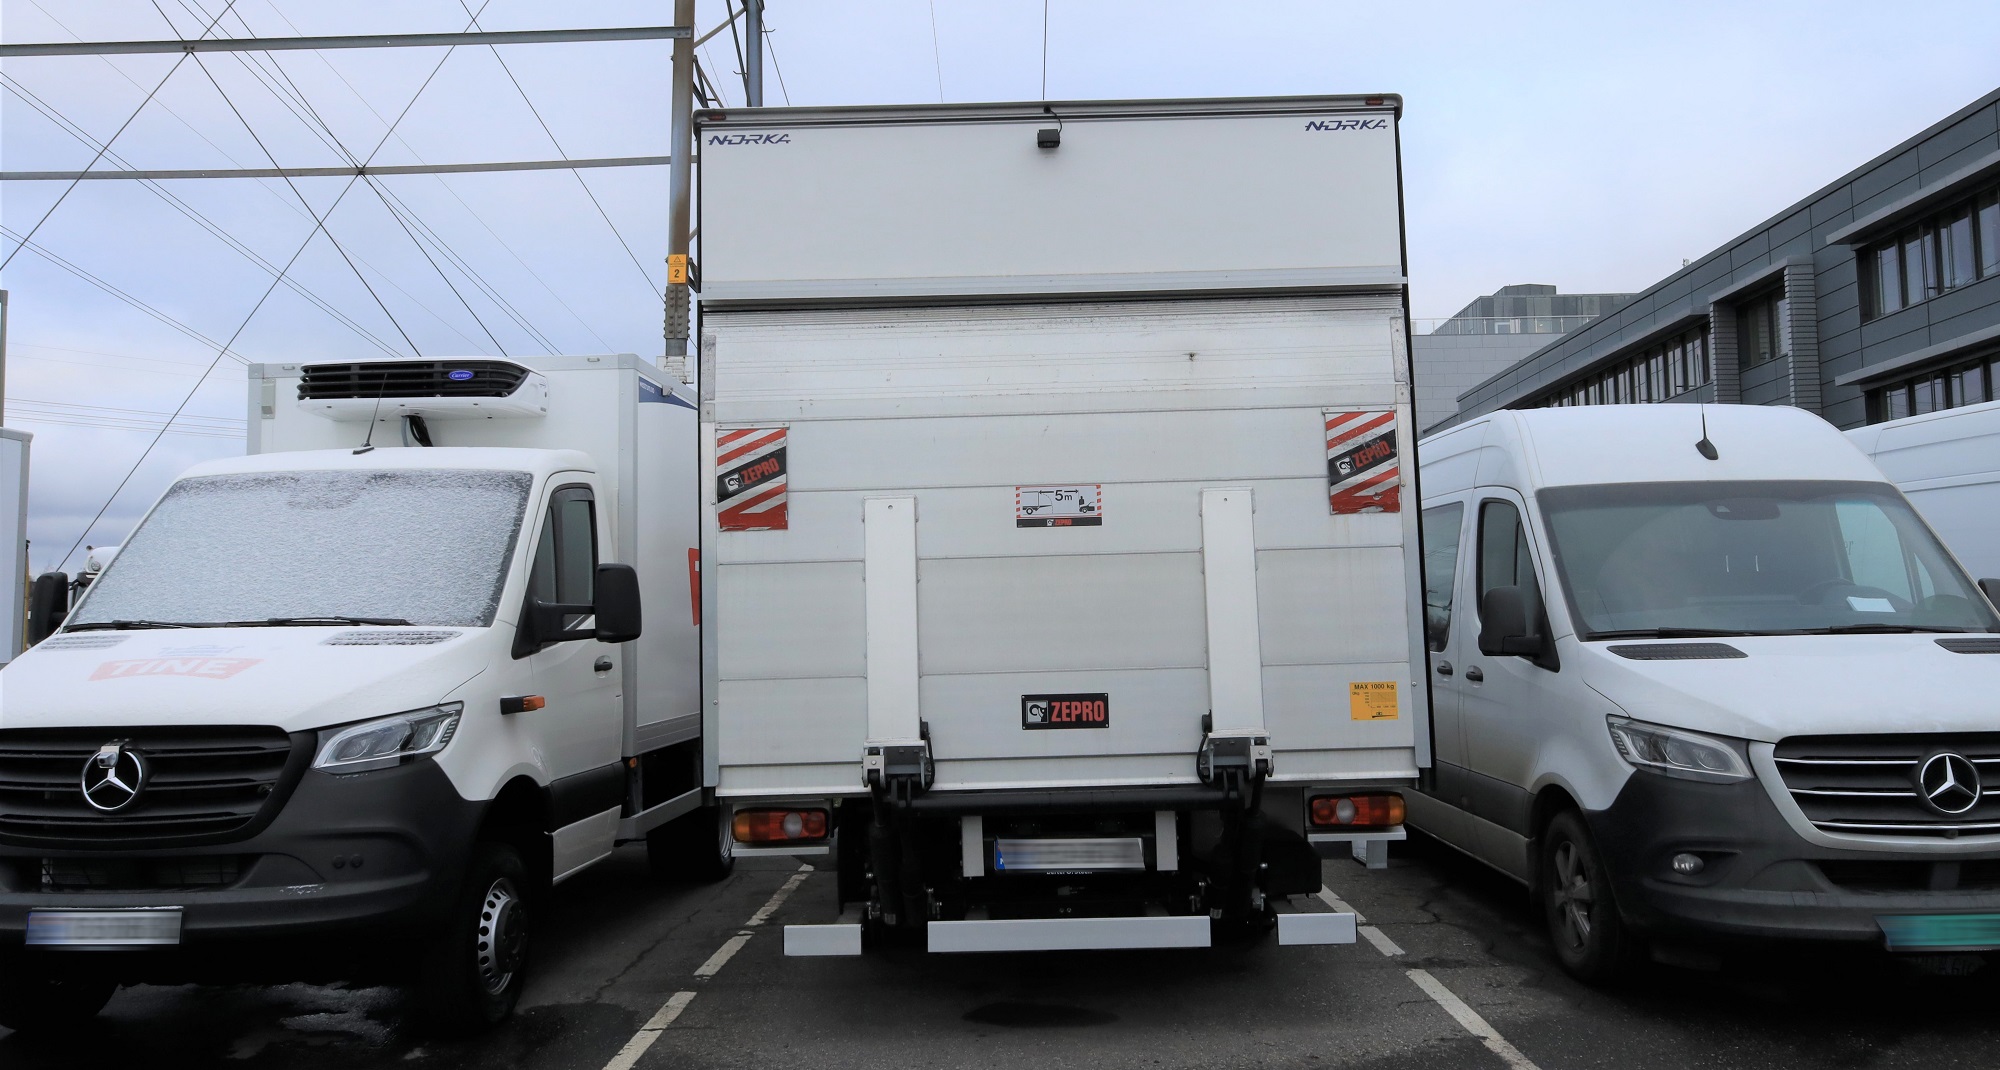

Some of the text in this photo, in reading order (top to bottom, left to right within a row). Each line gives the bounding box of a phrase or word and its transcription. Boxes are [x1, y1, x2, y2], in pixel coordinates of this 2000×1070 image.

[1304, 118, 1388, 132] NORKA
[708, 133, 791, 146] NORKA
[674, 269, 680, 278] 2
[1351, 440, 1391, 468] ZEPRO
[740, 457, 780, 485] ZEPRO
[107, 658, 239, 676] TINE
[1051, 700, 1104, 722] ZEPRO
